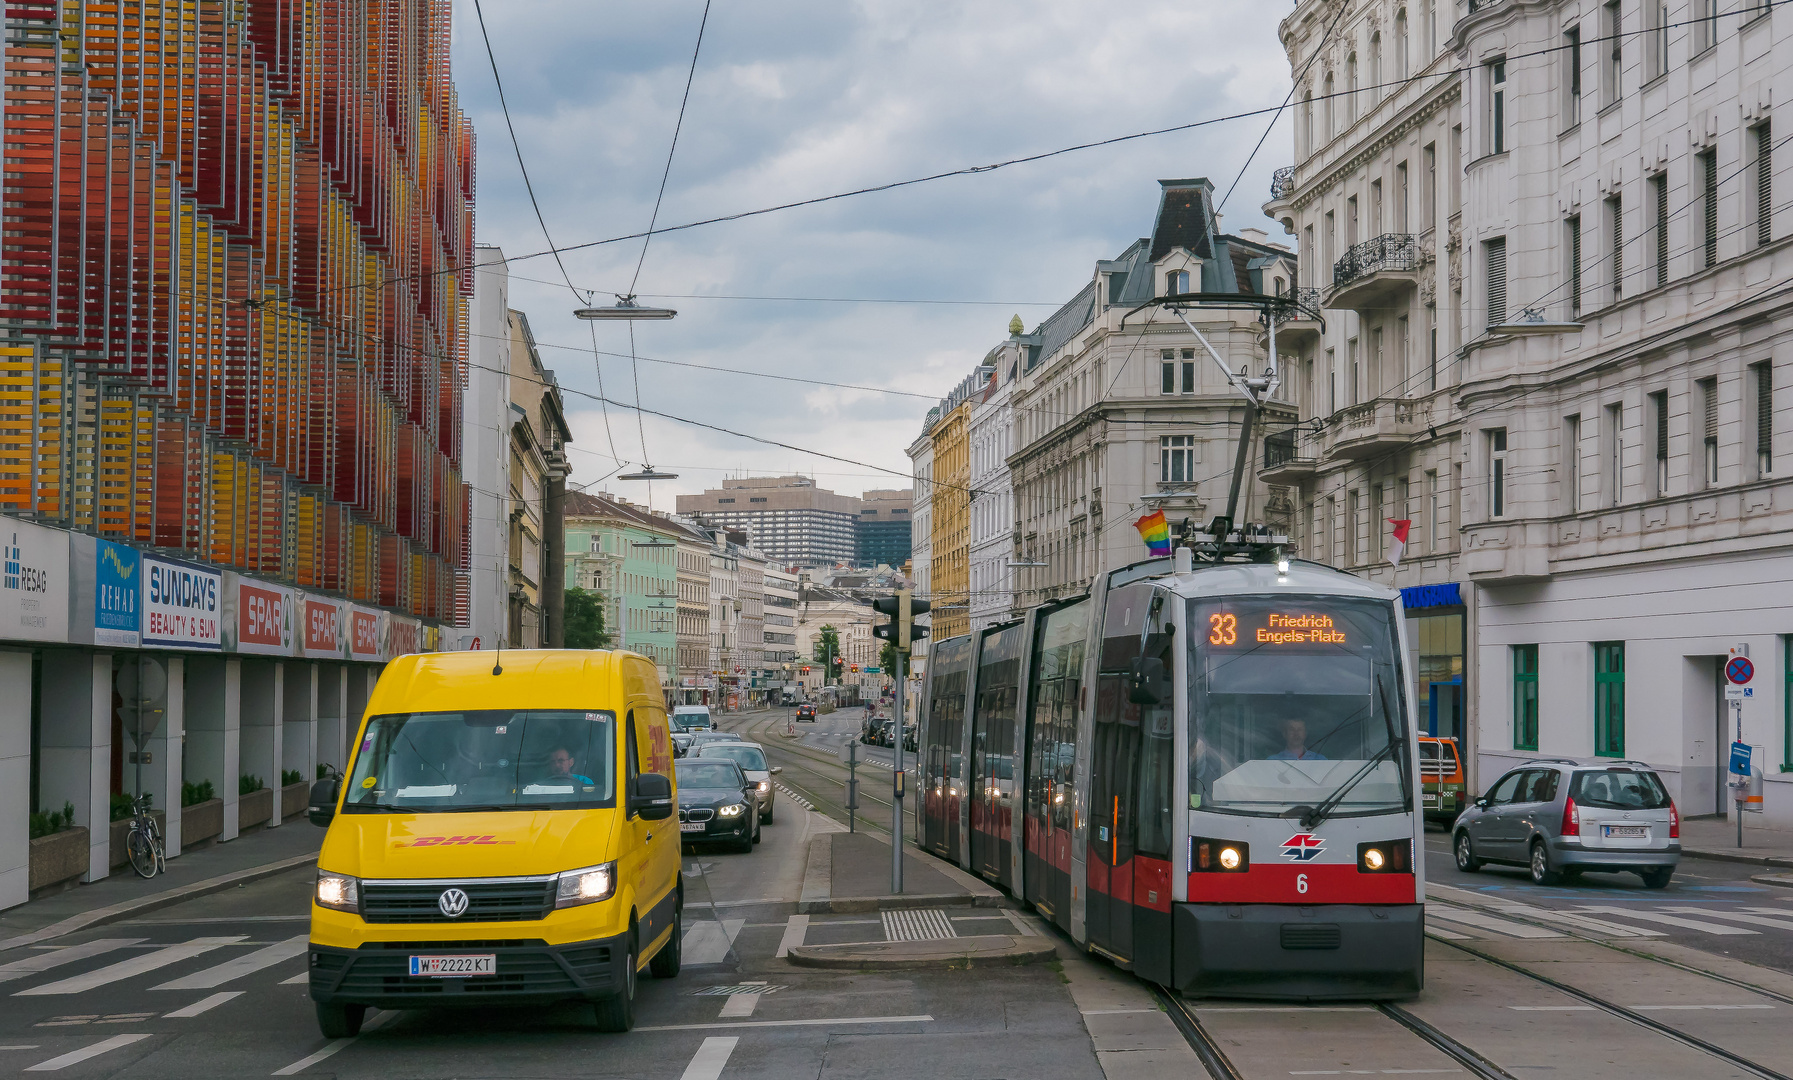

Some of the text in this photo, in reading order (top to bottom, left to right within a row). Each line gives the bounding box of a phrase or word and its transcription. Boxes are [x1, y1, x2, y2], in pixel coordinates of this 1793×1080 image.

[21, 566, 47, 593] RESAG
[150, 565, 216, 612] SUNDAYS
[101, 584, 134, 613] REHAB
[150, 612, 216, 639] BEAUTY & SUN
[248, 595, 281, 638] SPAR
[311, 608, 336, 644] SPAR
[1209, 613, 1237, 646] 33
[1269, 614, 1333, 628] Friedrich
[357, 618, 376, 648] SPAR
[1256, 628, 1345, 644] Engels-Platz
[411, 835, 499, 847] DHL
[1297, 873, 1308, 894] 6
[421, 960, 430, 972] W
